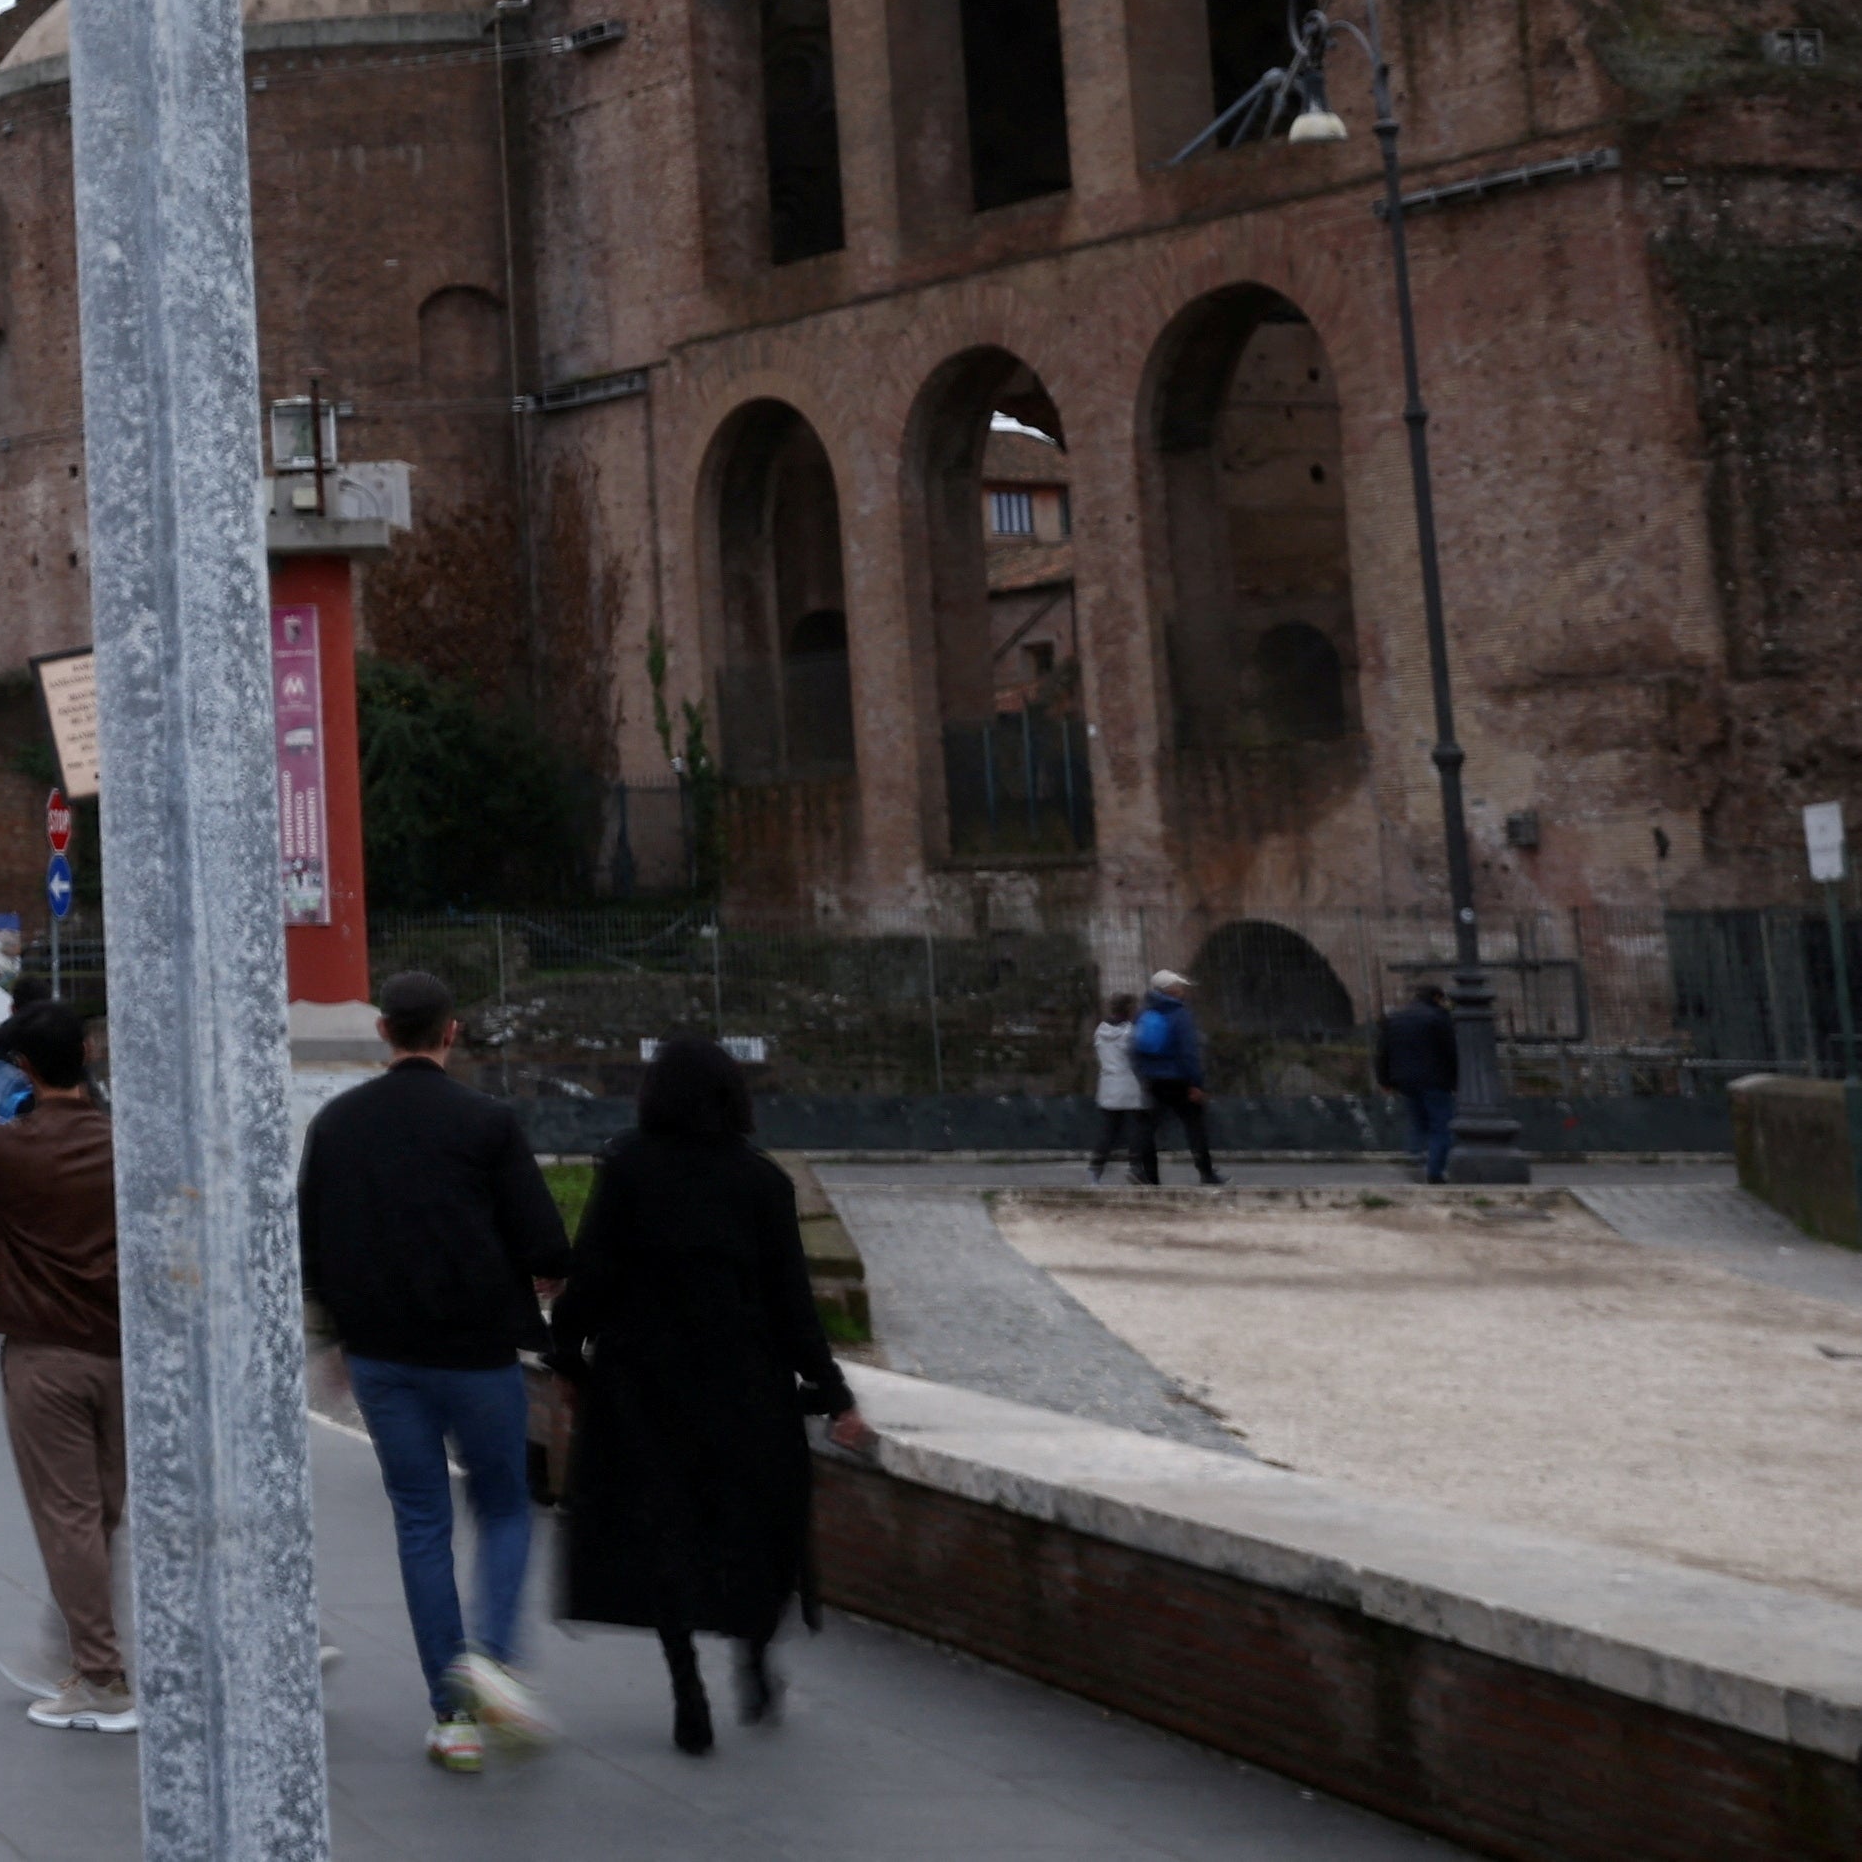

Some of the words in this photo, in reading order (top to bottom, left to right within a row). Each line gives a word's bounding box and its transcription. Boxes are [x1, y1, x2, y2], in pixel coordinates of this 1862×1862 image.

[48, 809, 69, 831] STOP
[282, 770, 295, 856] MONITORAGGIO
[307, 787, 318, 856] MONUMENTI
